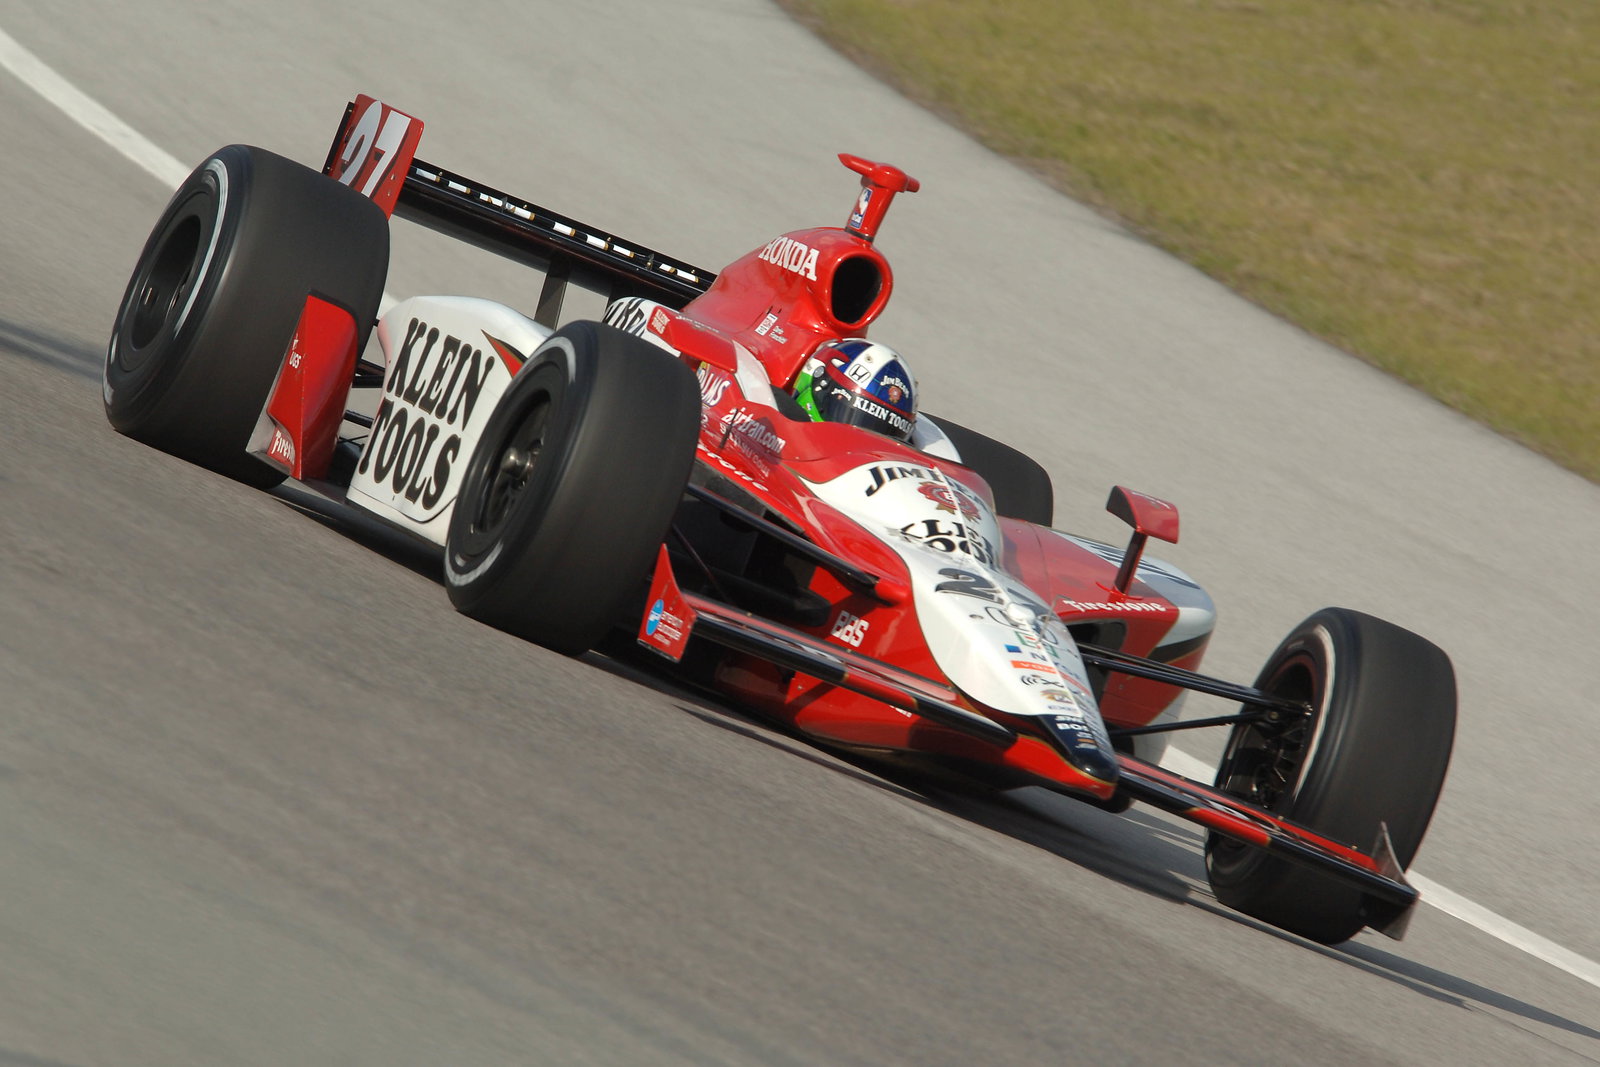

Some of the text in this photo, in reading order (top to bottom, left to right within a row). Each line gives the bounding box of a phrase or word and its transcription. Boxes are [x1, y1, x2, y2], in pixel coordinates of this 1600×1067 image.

[338, 100, 412, 198] 27
[758, 236, 820, 281] HONDA
[387, 317, 495, 432] KLEIN
[721, 407, 786, 454] airtran.com
[853, 396, 913, 434] KLEIN TOOLS
[358, 399, 461, 510] TOOLS
[829, 609, 870, 648] BBS
[1062, 599, 1168, 613] Firestone
